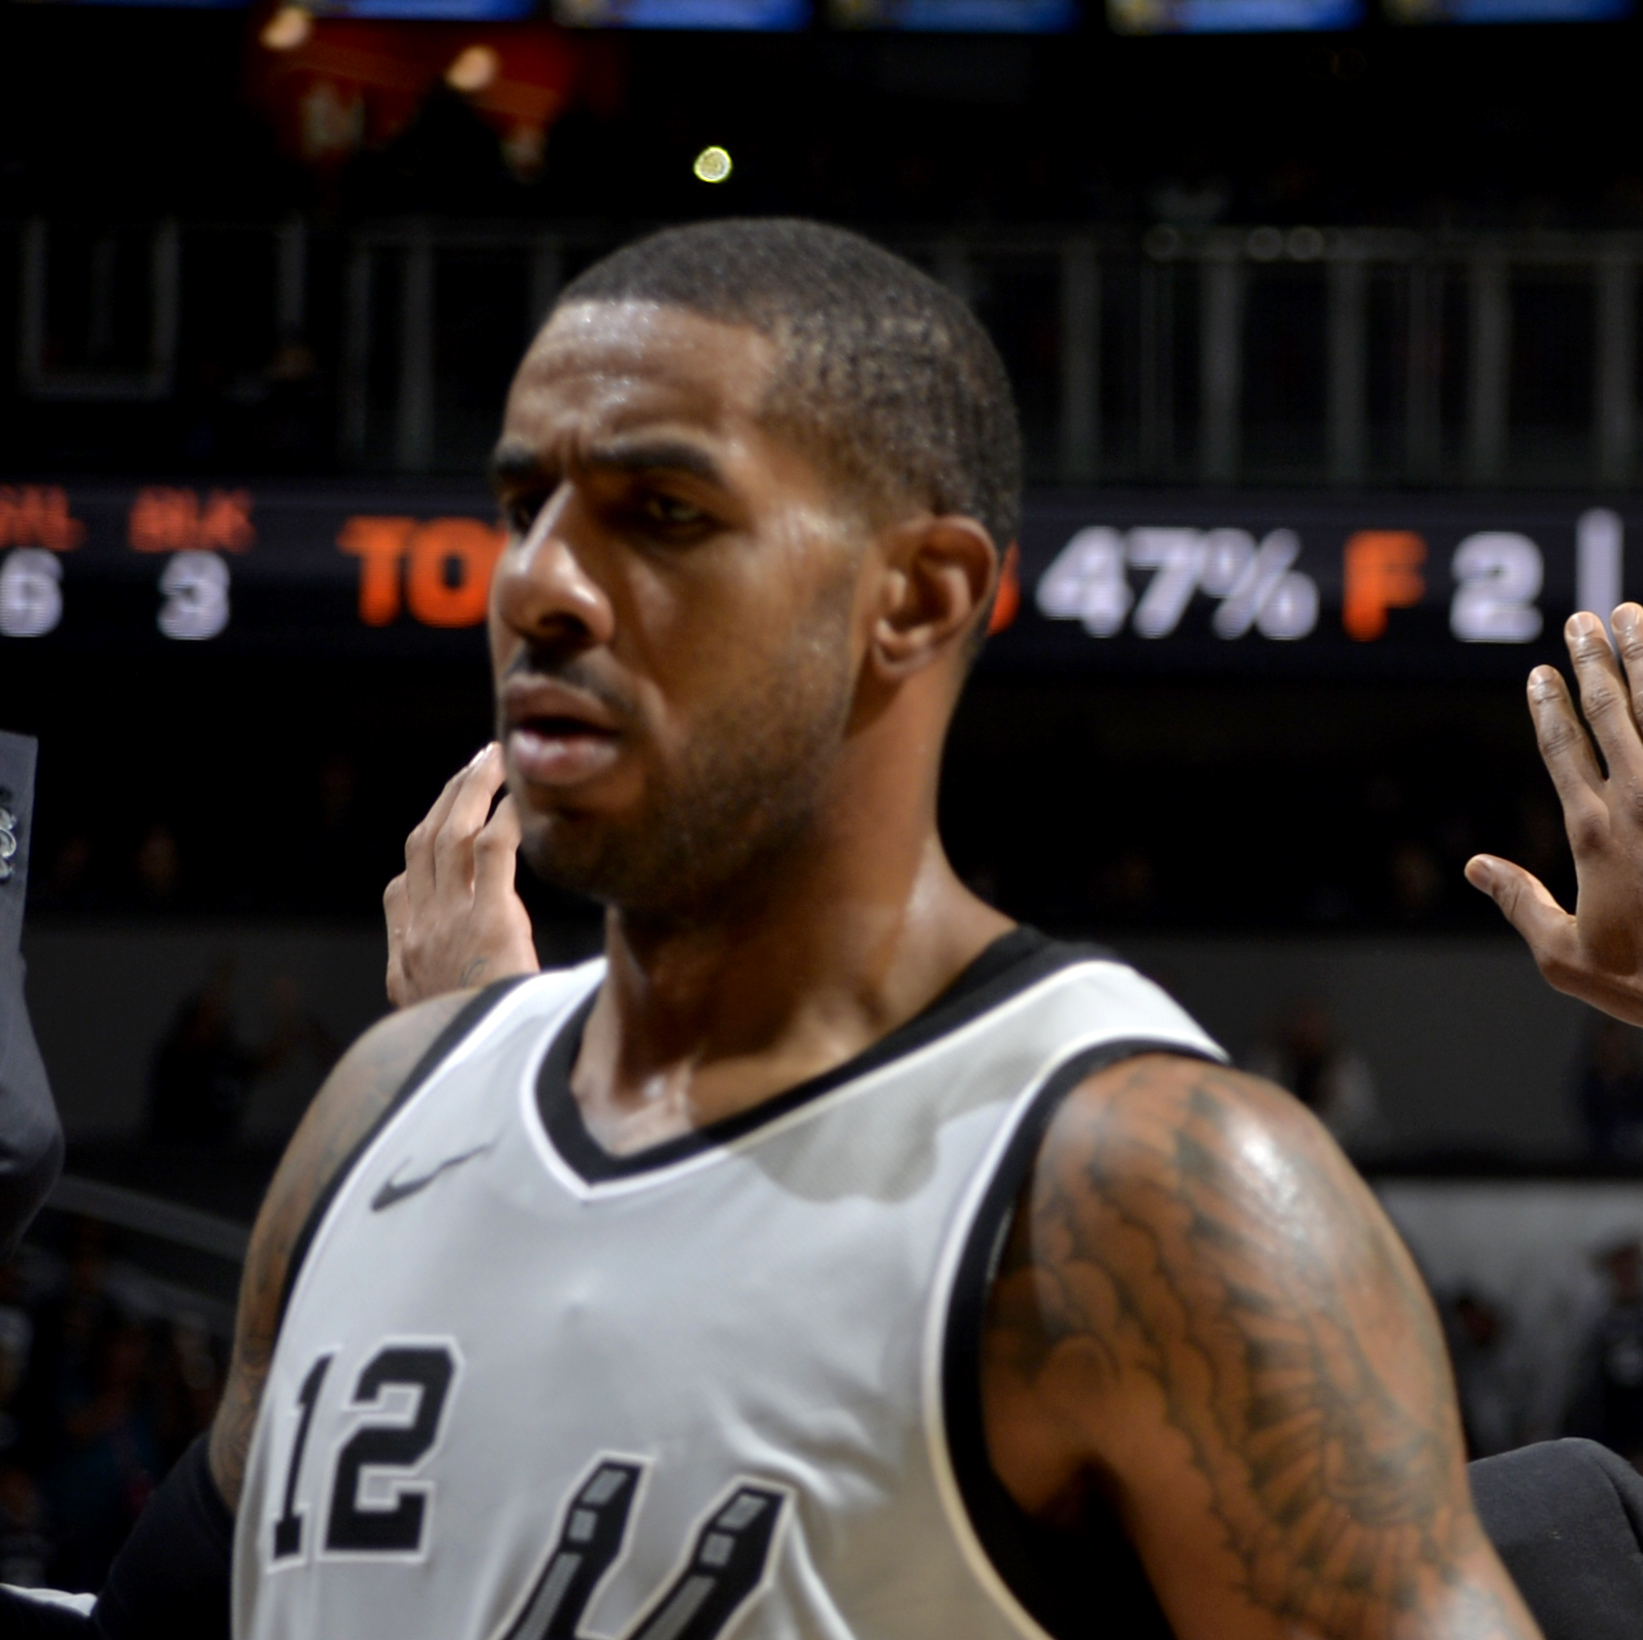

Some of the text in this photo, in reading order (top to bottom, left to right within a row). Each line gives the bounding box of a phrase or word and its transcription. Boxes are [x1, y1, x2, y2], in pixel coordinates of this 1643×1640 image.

[157, 550, 230, 640] 3
[1037, 526, 1319, 640] 47%
[1344, 530, 1427, 640] F
[1450, 531, 1545, 643] 2
[268, 1334, 466, 1574] 12
